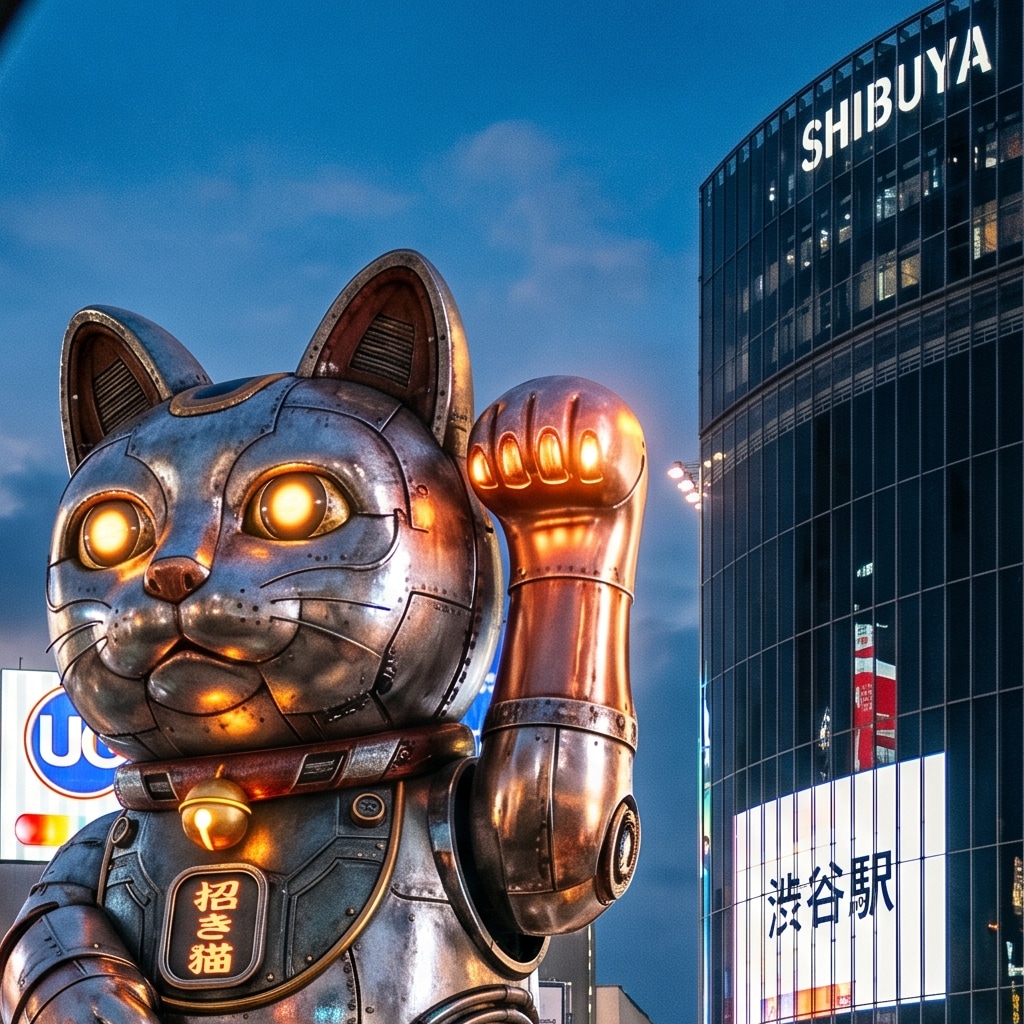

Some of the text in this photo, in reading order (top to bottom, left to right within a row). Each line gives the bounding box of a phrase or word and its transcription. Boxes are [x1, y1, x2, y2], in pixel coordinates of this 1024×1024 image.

[801, 25, 992, 172] SHIBUYA
[187, 880, 240, 975] 招き猫
[767, 849, 895, 939] 渋谷駅
